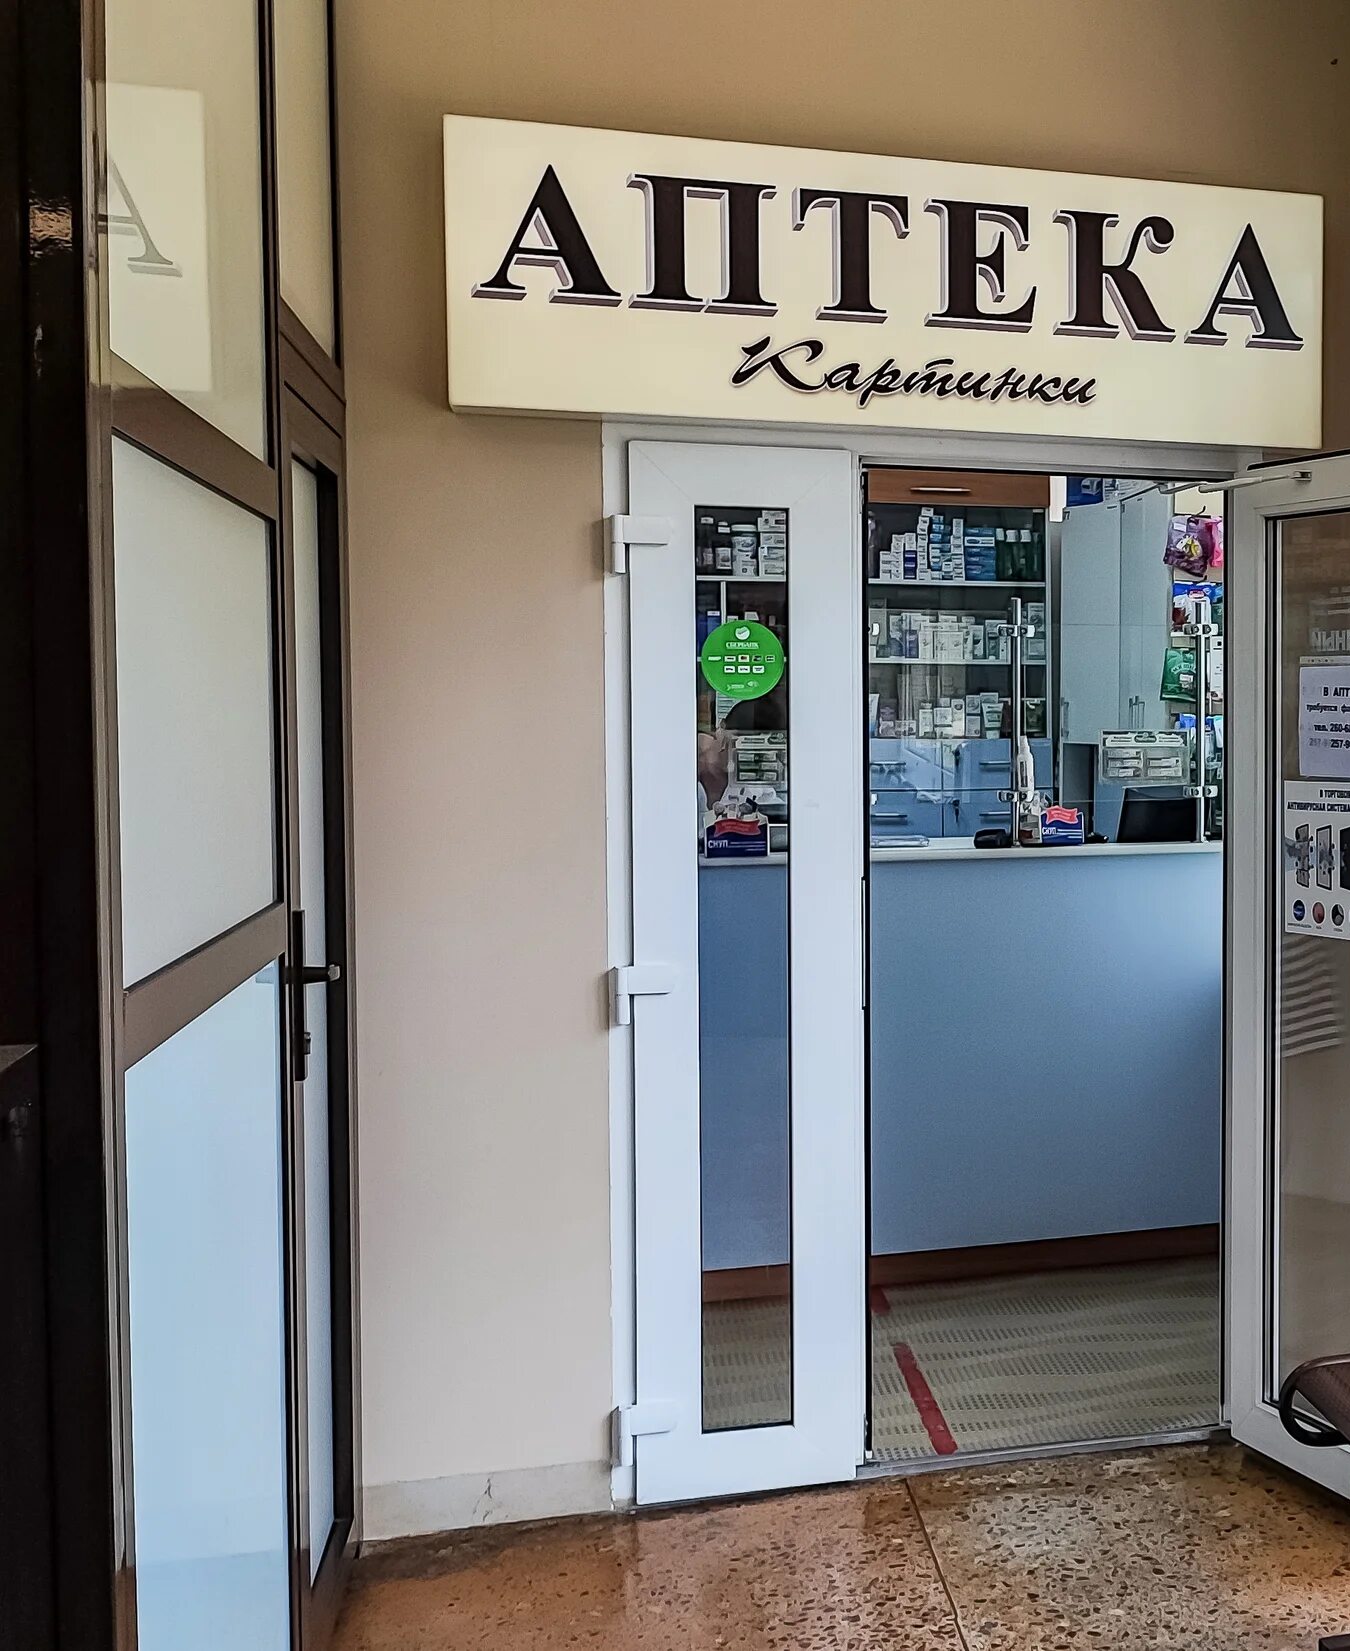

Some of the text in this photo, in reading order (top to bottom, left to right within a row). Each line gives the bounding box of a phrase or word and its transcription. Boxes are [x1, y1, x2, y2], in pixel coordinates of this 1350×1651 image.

[470, 163, 1304, 350] АПТЕКА
[731, 335, 1098, 408] Картинки
[1323, 686, 1329, 697] В
